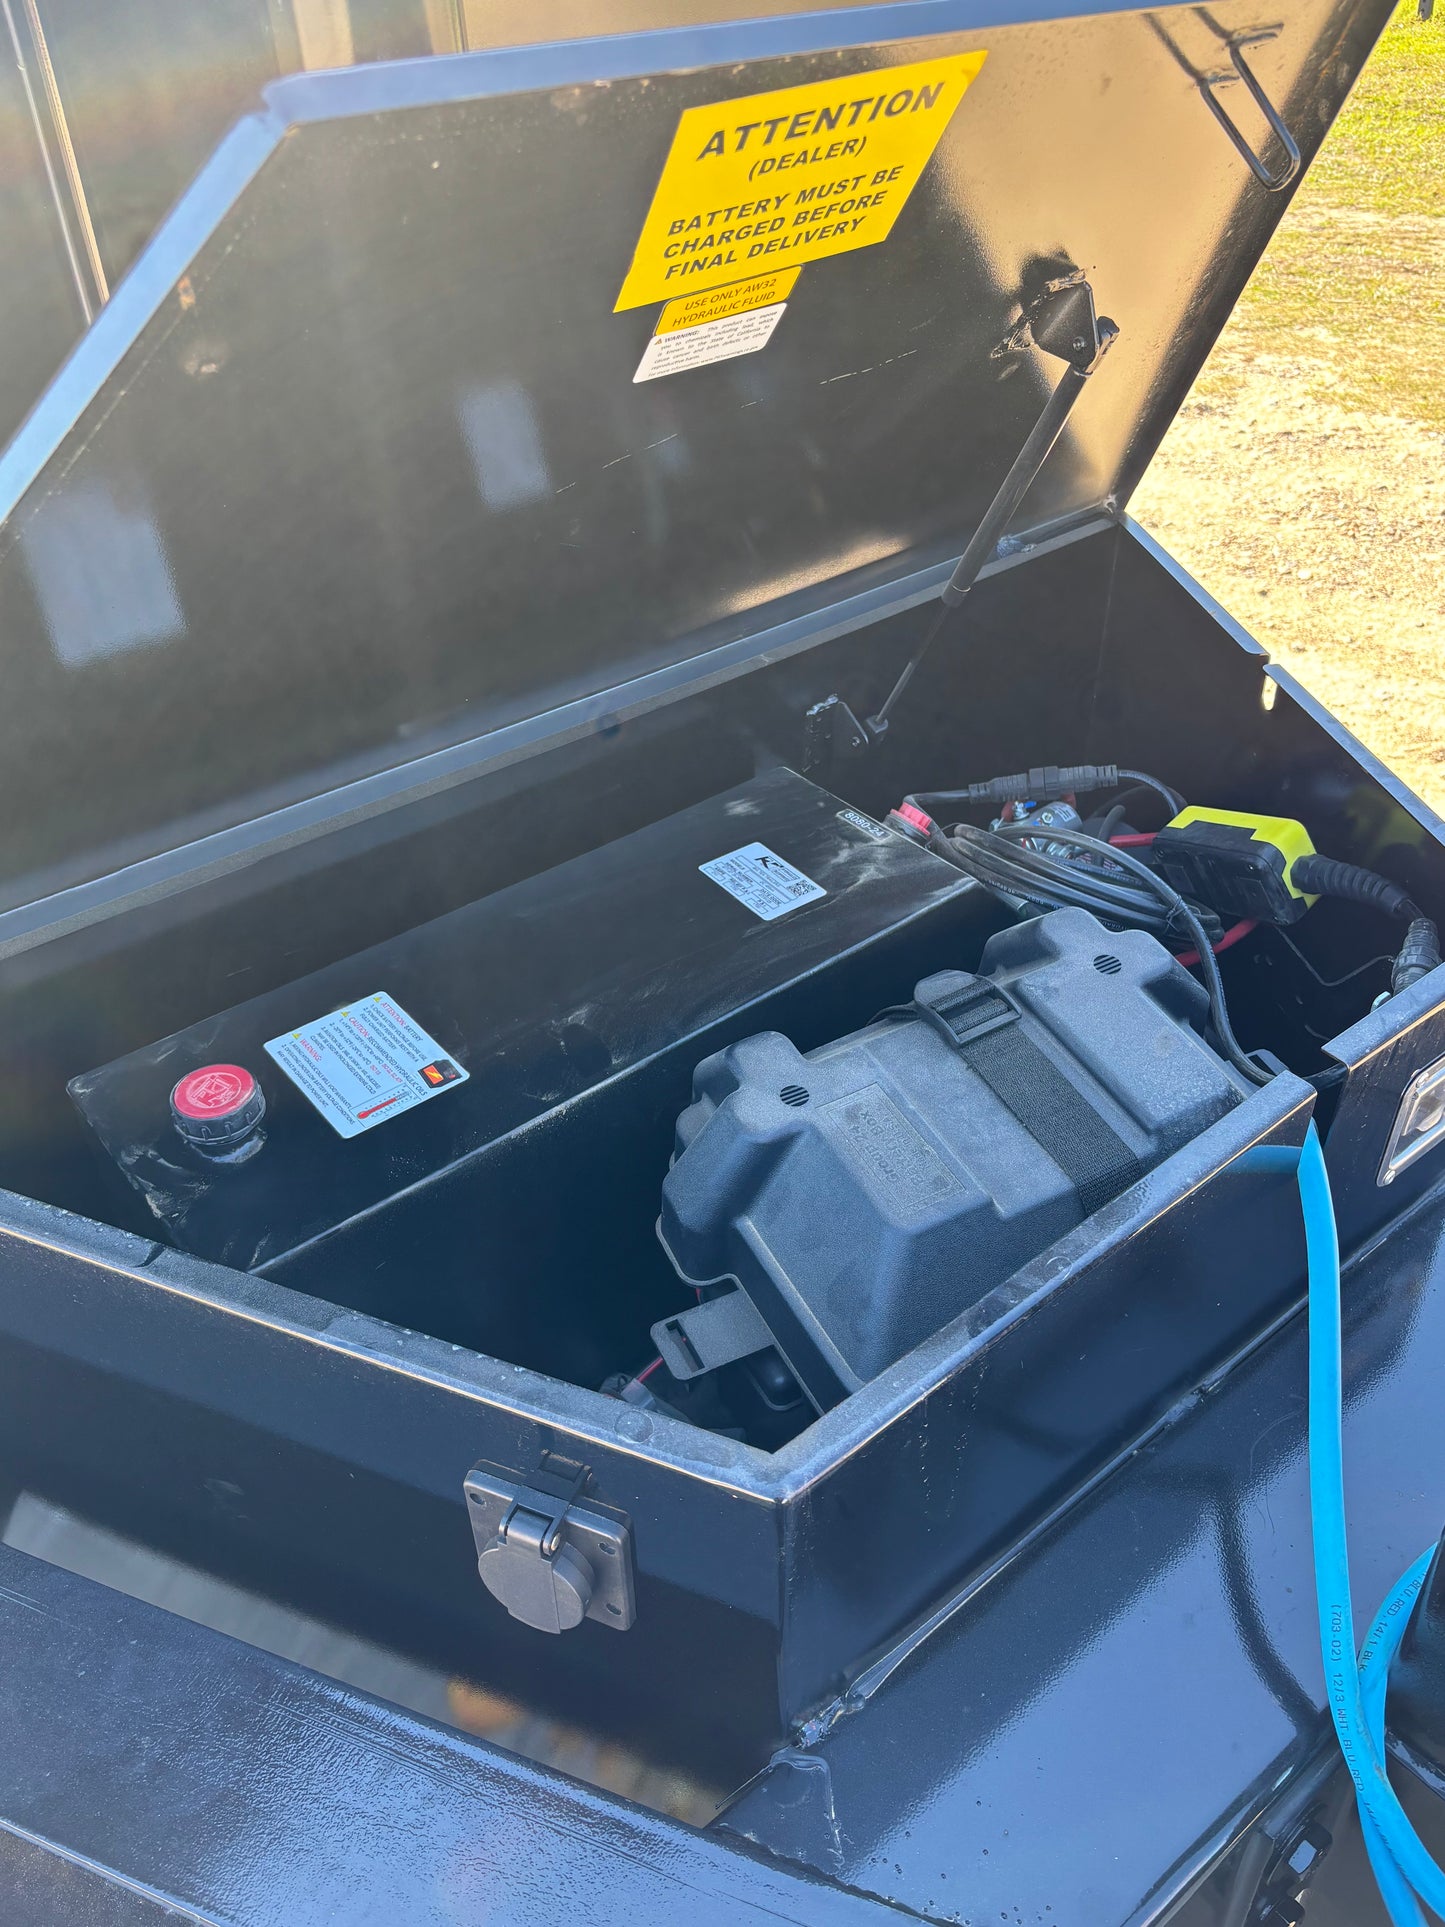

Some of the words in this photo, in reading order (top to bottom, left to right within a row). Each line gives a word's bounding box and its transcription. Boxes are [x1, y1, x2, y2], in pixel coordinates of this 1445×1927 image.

[697, 82, 945, 160] ATTENTION
[748, 136, 867, 181] (DEALER)
[668, 193, 790, 236] BATTERY
[794, 175, 861, 206] MUST
[870, 166, 904, 186] BE
[663, 216, 788, 259] CHARGED
[793, 191, 888, 226] BEFORE
[664, 250, 737, 280] FINAL
[747, 216, 867, 259] DELIVERY
[672, 300, 741, 326] HYDRAULIC
[741, 290, 776, 306] FLUID
[684, 296, 708, 310] USE
[709, 287, 742, 304] ONLY
[743, 278, 777, 294] AW32
[663, 329, 700, 343] WARNING:
[844, 812, 884, 837] 8080-24
[849, 1125, 865, 1143] 24
[864, 1143, 899, 1183] Group
[1330, 1604, 1342, 1662] (703-02)
[1333, 1672, 1344, 1703] 12/3
